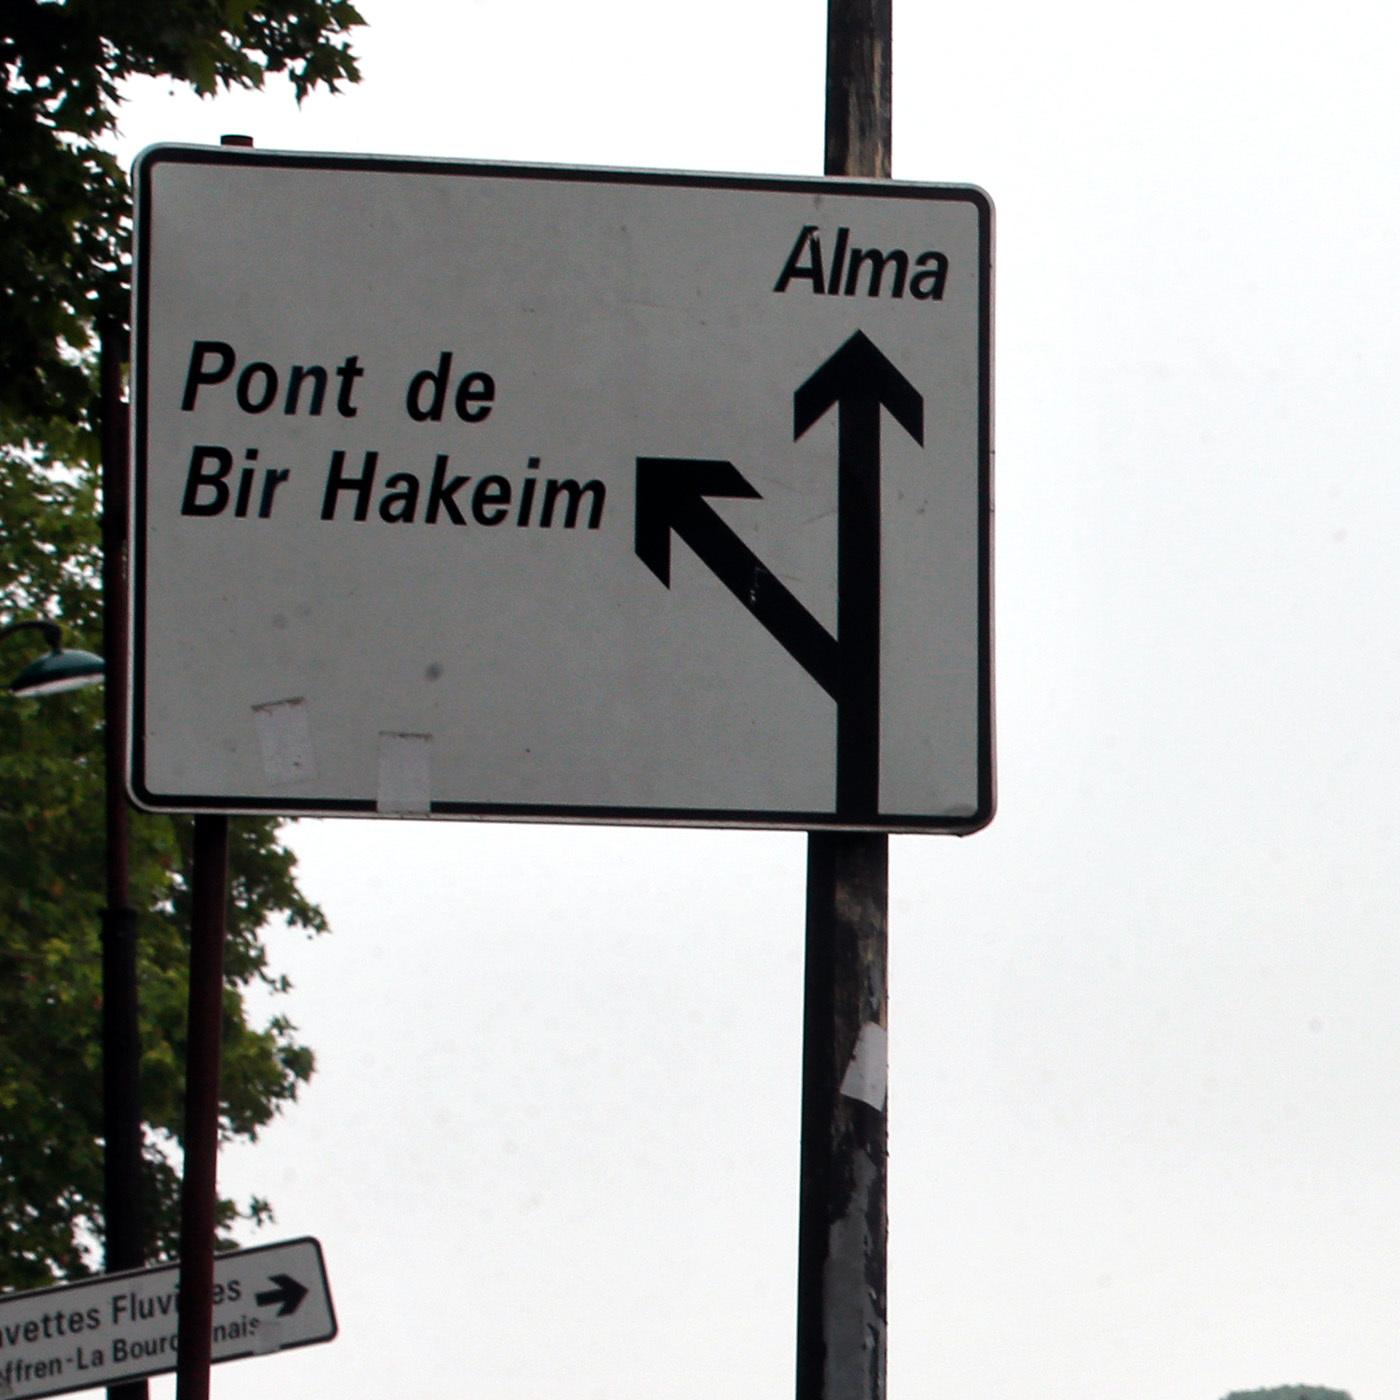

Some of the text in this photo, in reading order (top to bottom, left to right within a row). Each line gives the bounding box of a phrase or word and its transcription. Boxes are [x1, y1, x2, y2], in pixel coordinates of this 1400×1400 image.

[774, 226, 949, 301] Alma
[181, 341, 496, 424] Pont de
[181, 446, 607, 530] Bir Hakeim
[0, 1308, 101, 1348] vettes
[0, 1346, 104, 1386] ffren-La
